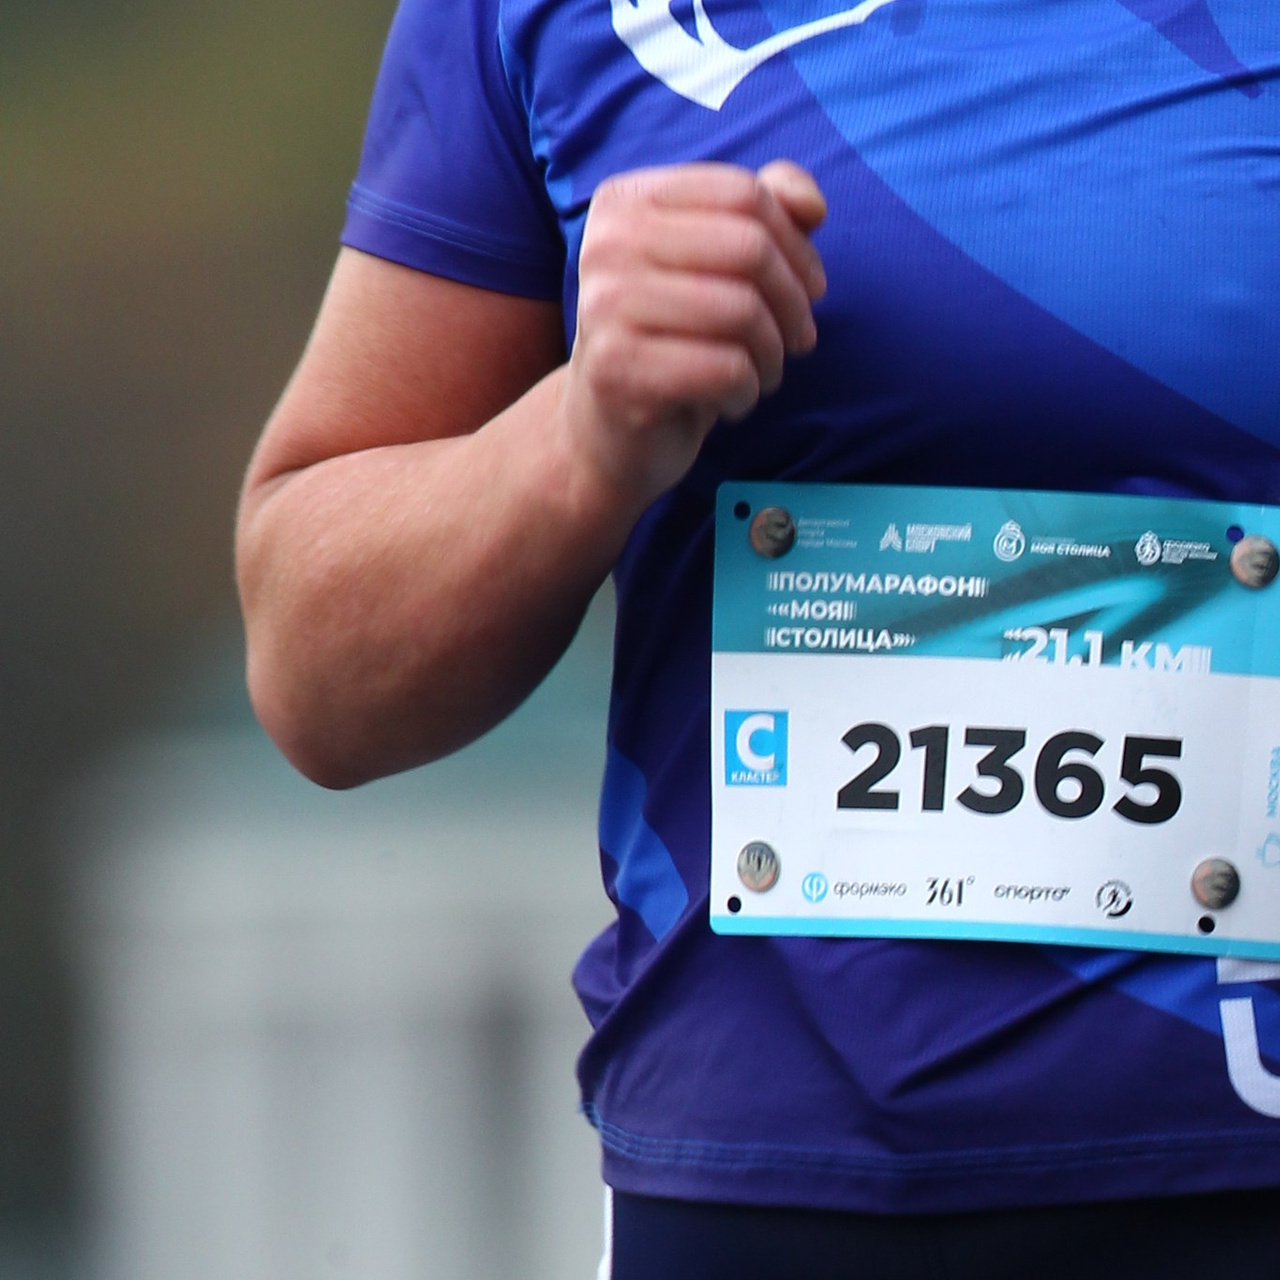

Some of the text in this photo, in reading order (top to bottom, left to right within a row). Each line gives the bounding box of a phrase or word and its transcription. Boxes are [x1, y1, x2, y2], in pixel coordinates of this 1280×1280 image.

[772, 571, 984, 597] ПОЛУМАРАФОН
[1010, 626, 1103, 666] 21.1
[836, 722, 1184, 826] 21365
